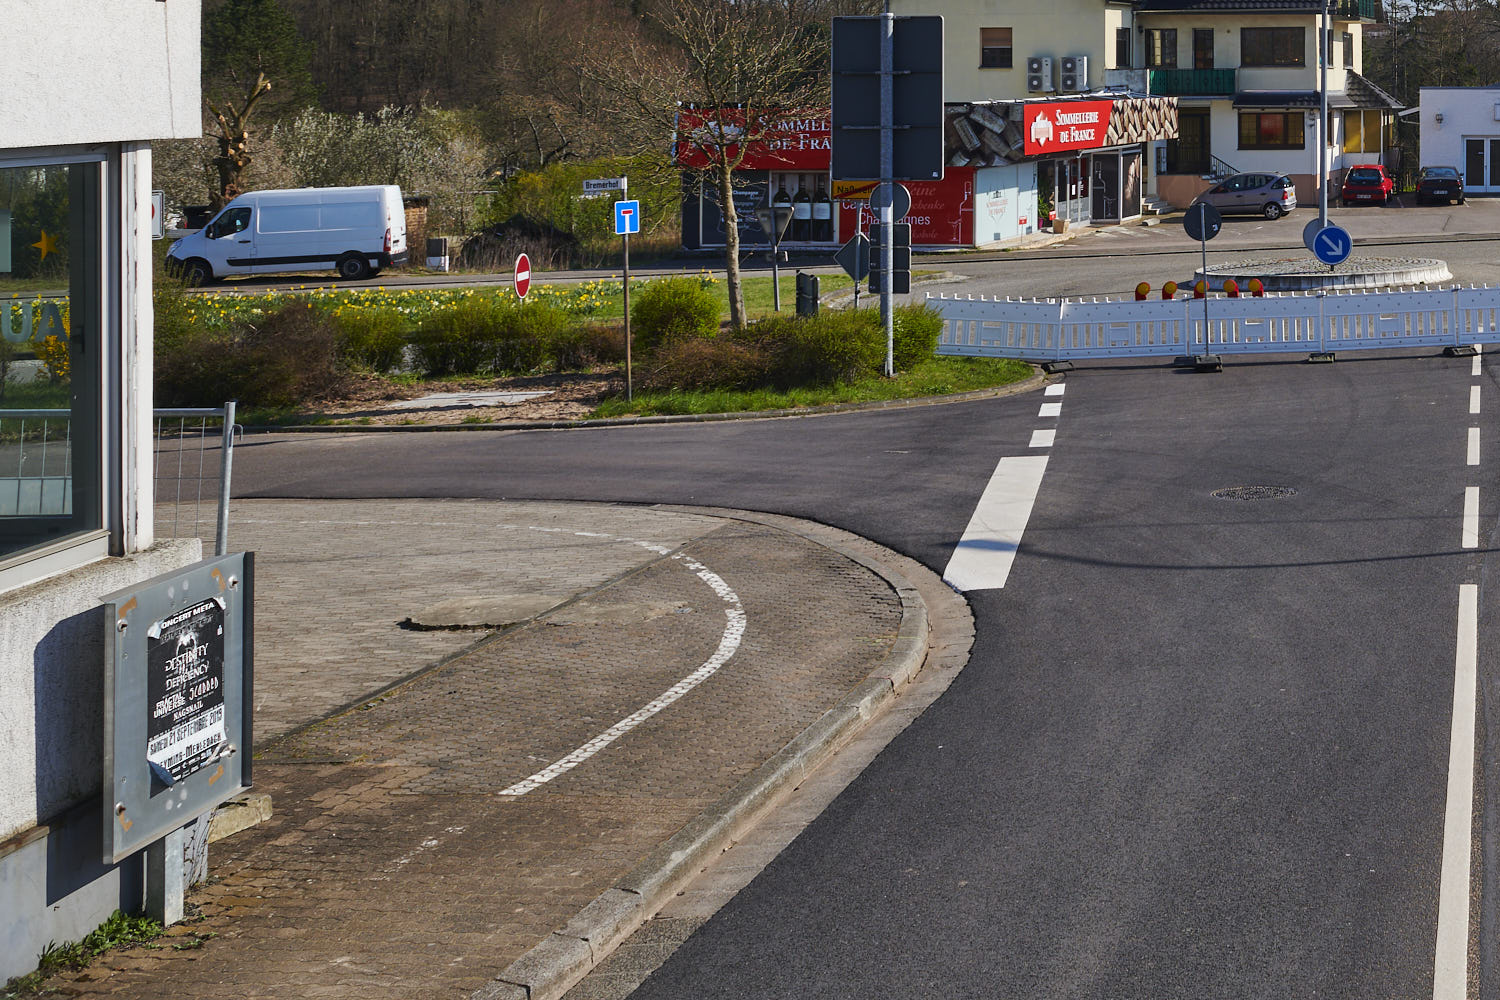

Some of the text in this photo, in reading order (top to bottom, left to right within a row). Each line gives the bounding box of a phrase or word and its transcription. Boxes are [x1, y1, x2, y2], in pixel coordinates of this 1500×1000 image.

[1055, 109, 1100, 126] SOMMELLERIE
[799, 133, 831, 150] FRA
[1060, 126, 1096, 143] DE FRANCE
[585, 180, 619, 190] Bremerhof
[860, 212, 931, 225] Chagnes
[161, 611, 192, 629] ONCERT
[193, 602, 215, 615] META
[153, 697, 186, 719] UNIVERSE
[173, 701, 204, 721] NAGSNAIL
